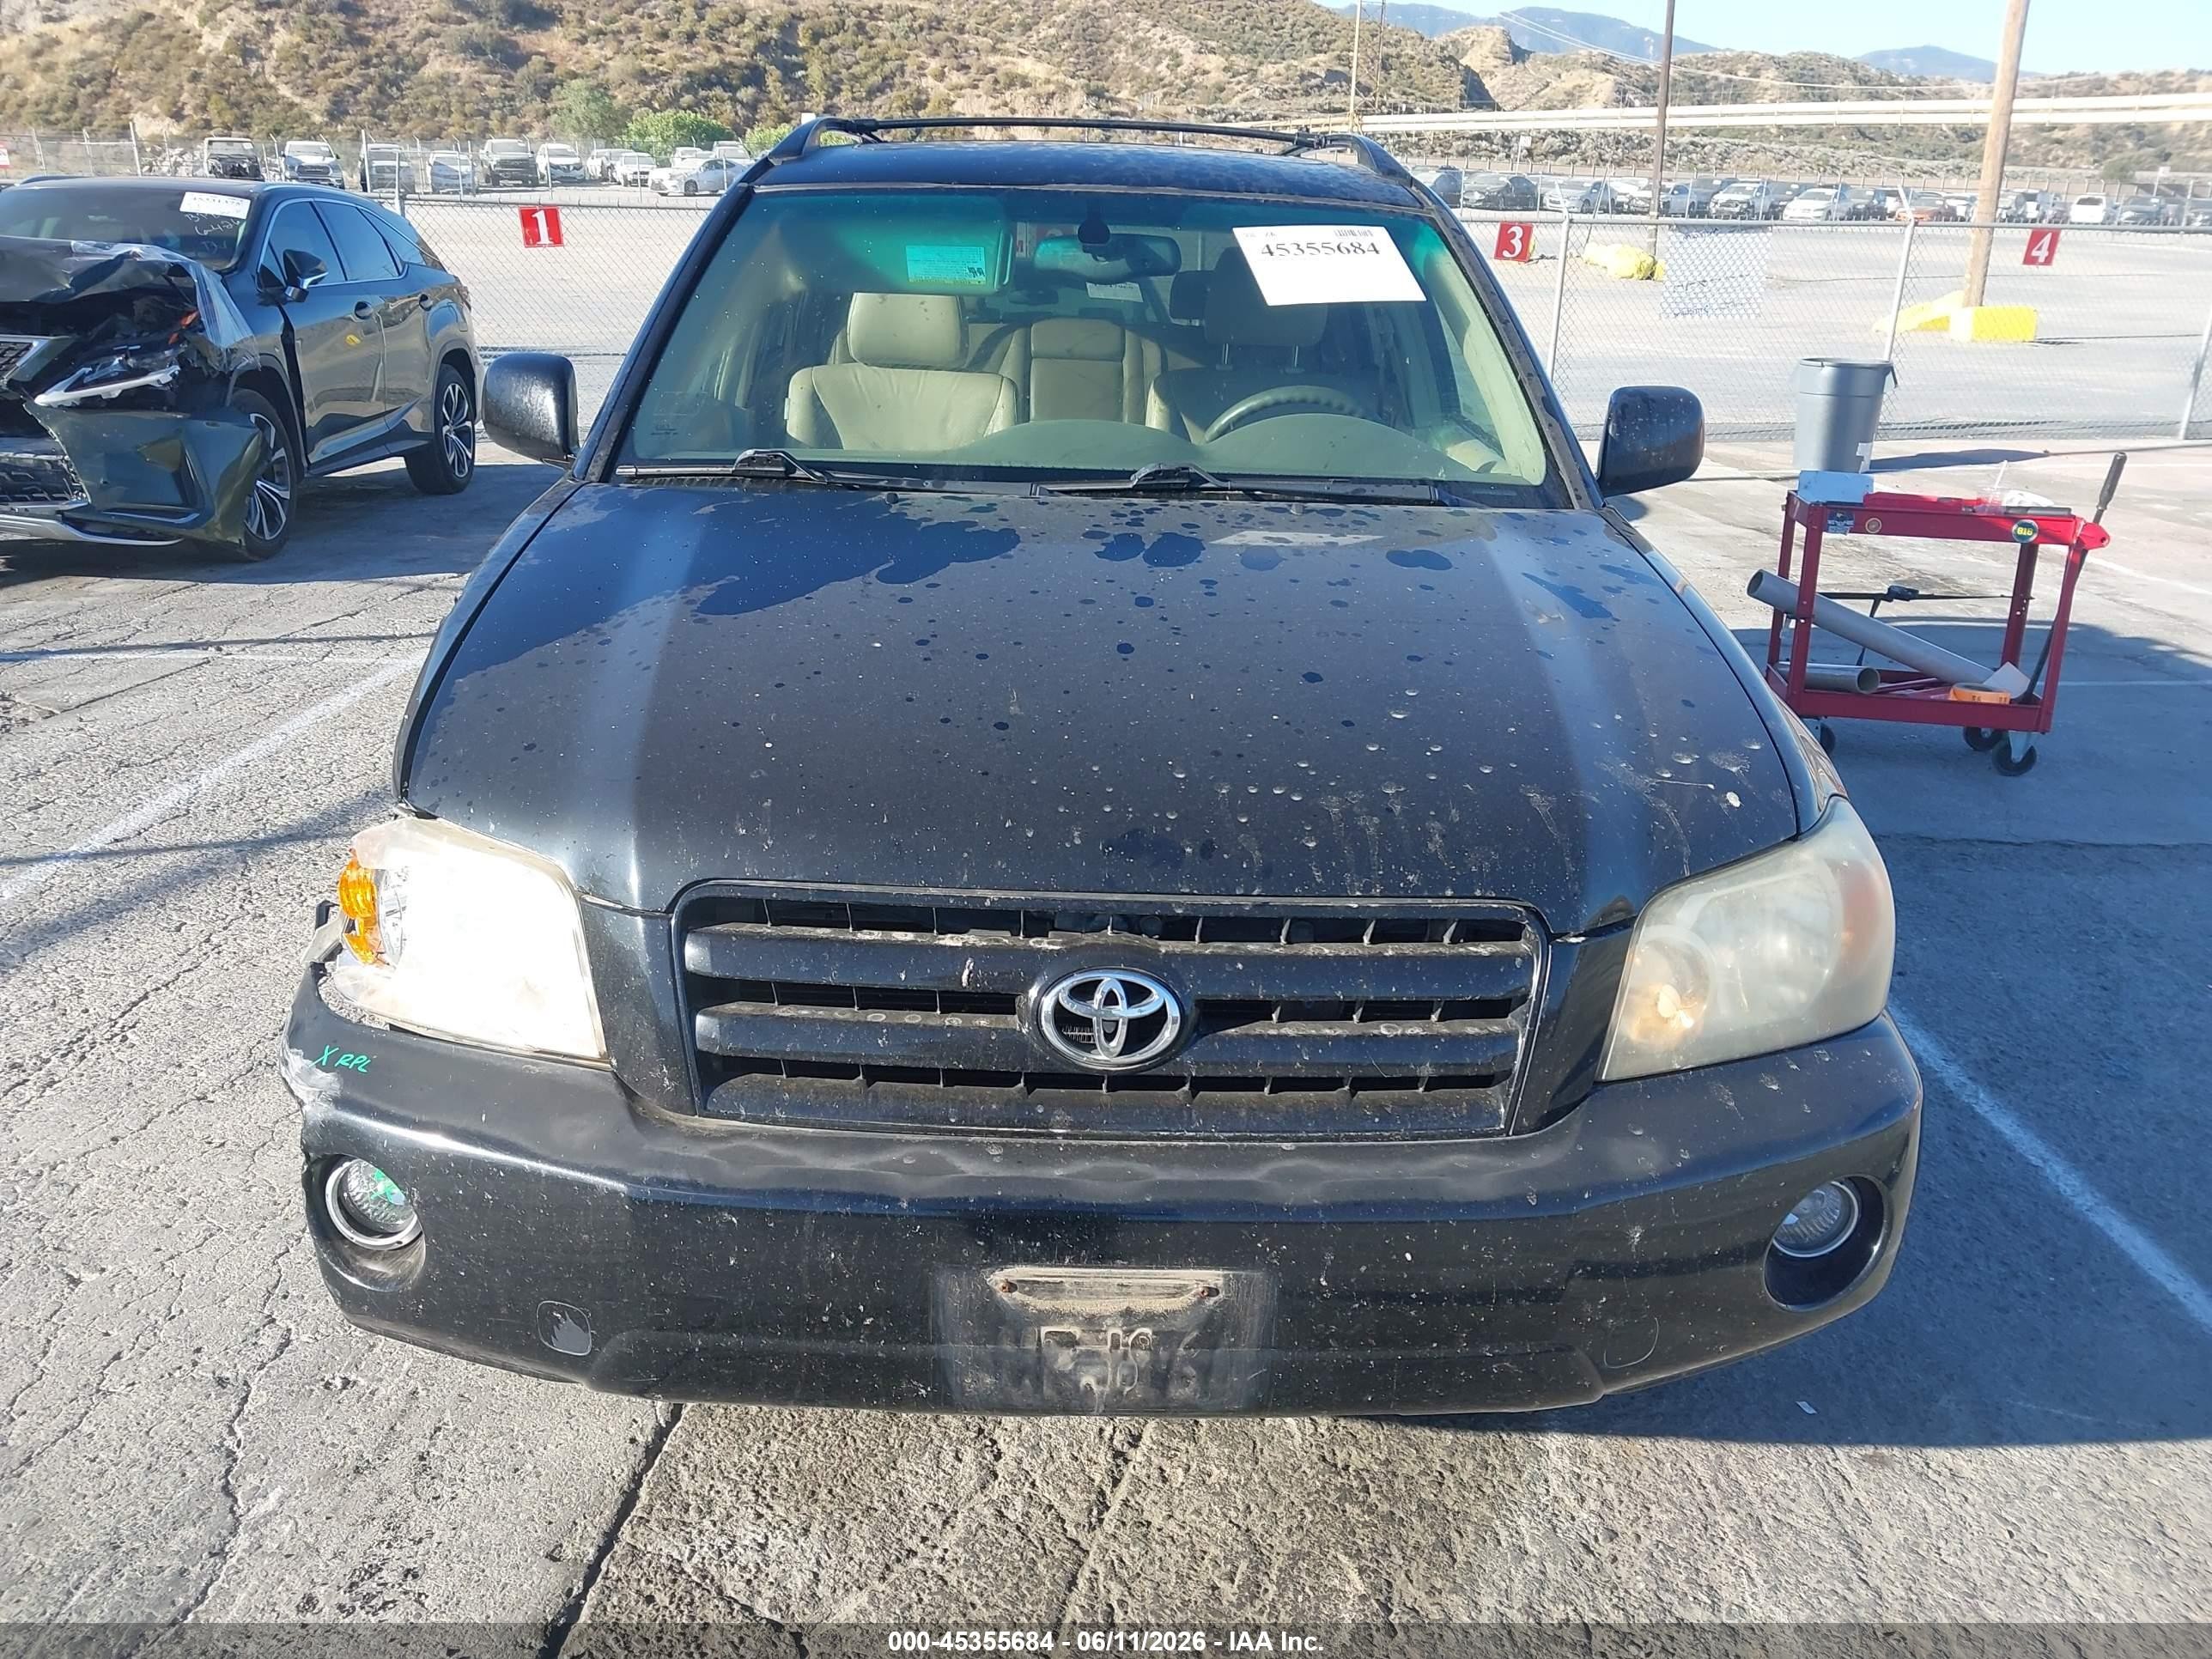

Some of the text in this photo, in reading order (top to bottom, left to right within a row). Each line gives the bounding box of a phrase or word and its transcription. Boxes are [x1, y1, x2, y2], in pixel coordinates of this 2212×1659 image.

[531, 210, 555, 246] 1
[1502, 225, 1523, 258] 3
[1261, 240, 1380, 258] 45355684
[2030, 233, 2052, 263] 4
[308, 1044, 340, 1069] X
